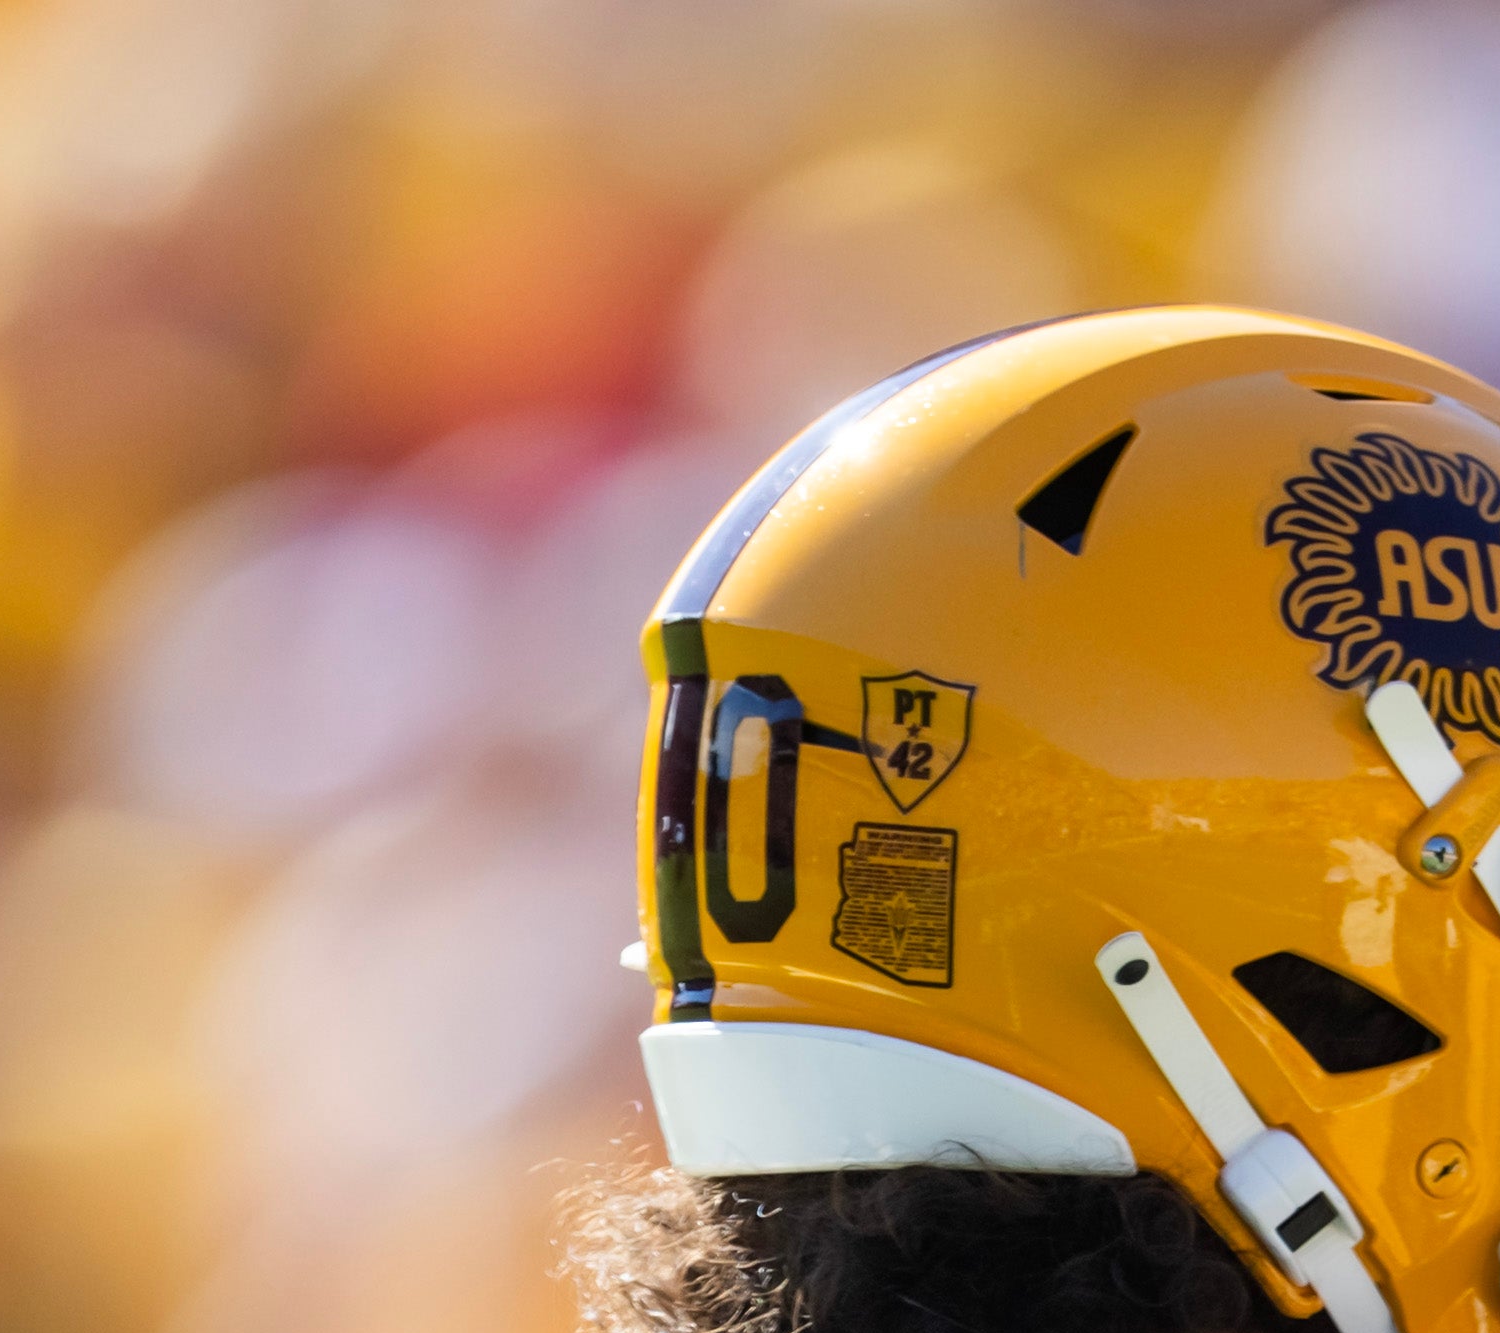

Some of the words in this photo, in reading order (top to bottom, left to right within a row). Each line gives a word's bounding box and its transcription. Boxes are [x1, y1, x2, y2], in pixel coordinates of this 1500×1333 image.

[892, 687, 937, 728] PT
[886, 740, 934, 781] 42
[704, 674, 804, 944] 0
